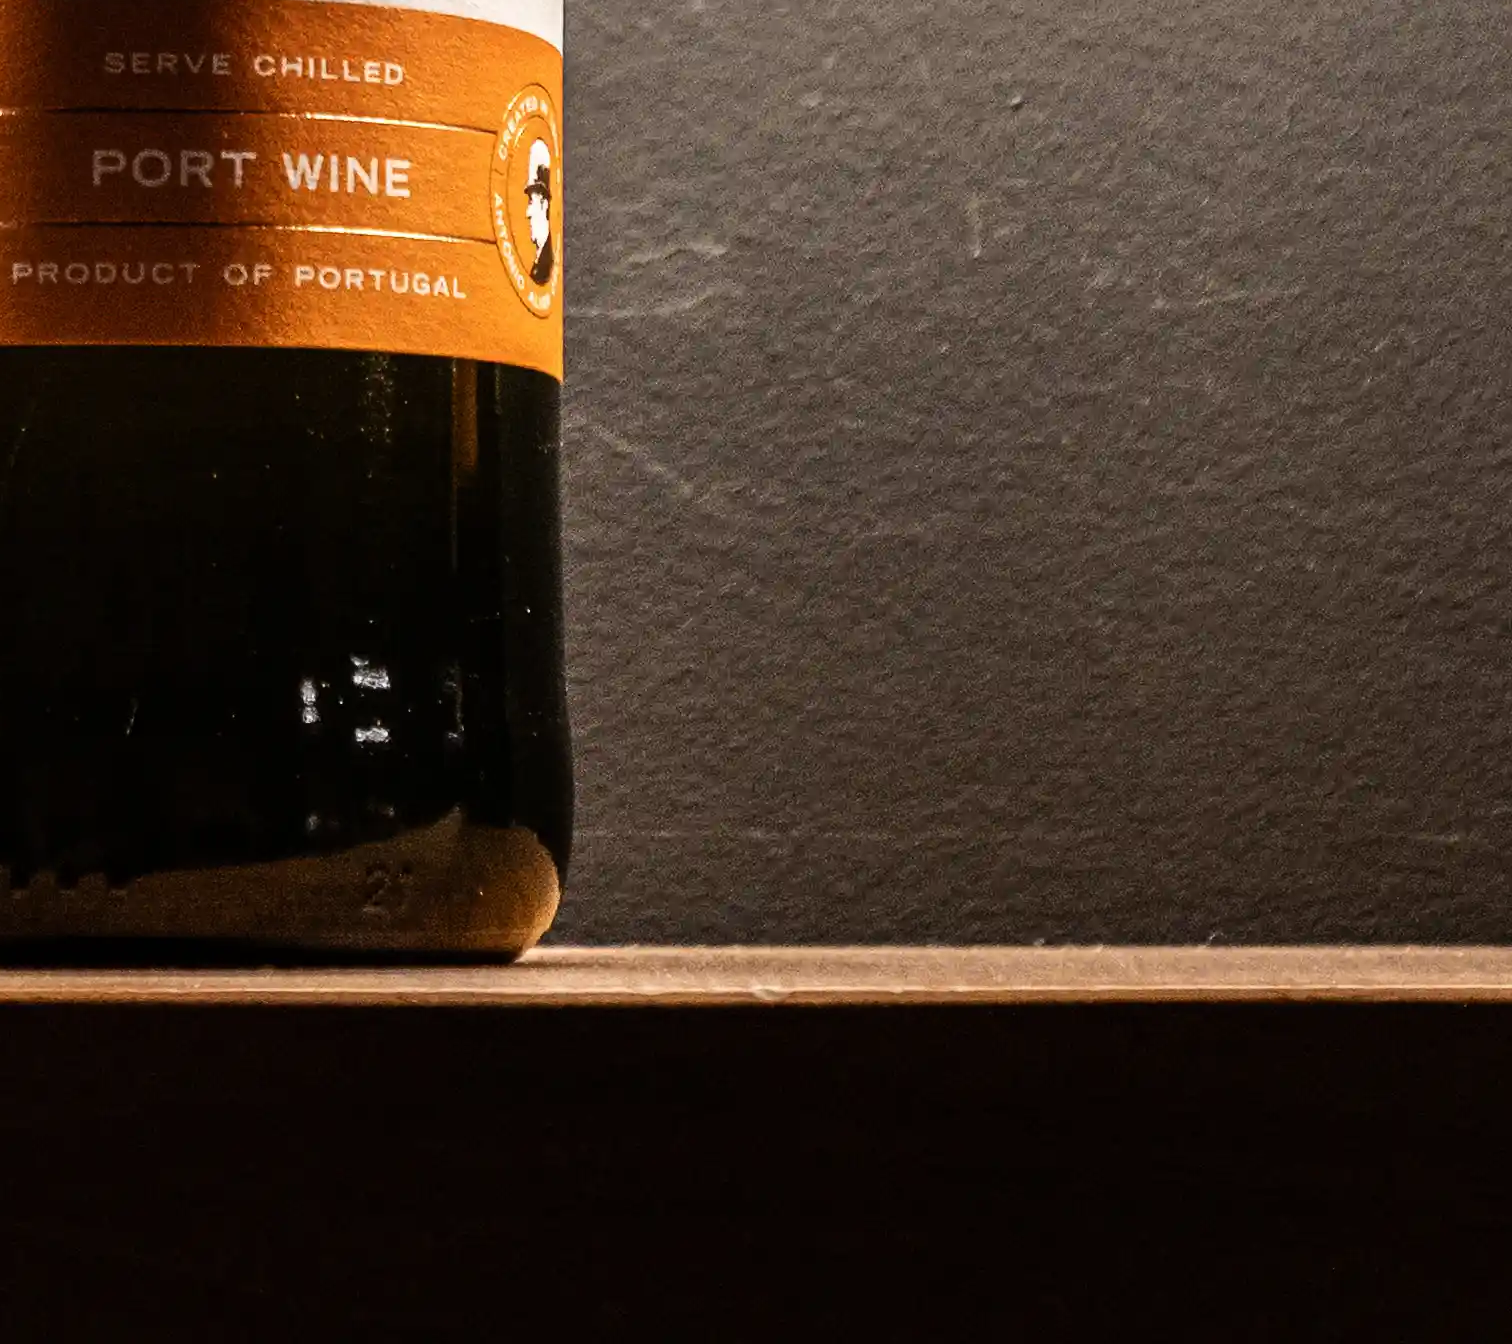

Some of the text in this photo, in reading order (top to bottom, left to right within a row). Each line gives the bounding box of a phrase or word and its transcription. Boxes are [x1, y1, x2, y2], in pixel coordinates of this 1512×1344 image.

[102, 50, 406, 88] SERVE CHILLED
[91, 148, 413, 199] PORT WINE
[10, 260, 468, 301] PRODUCT OF PORTUGAL
